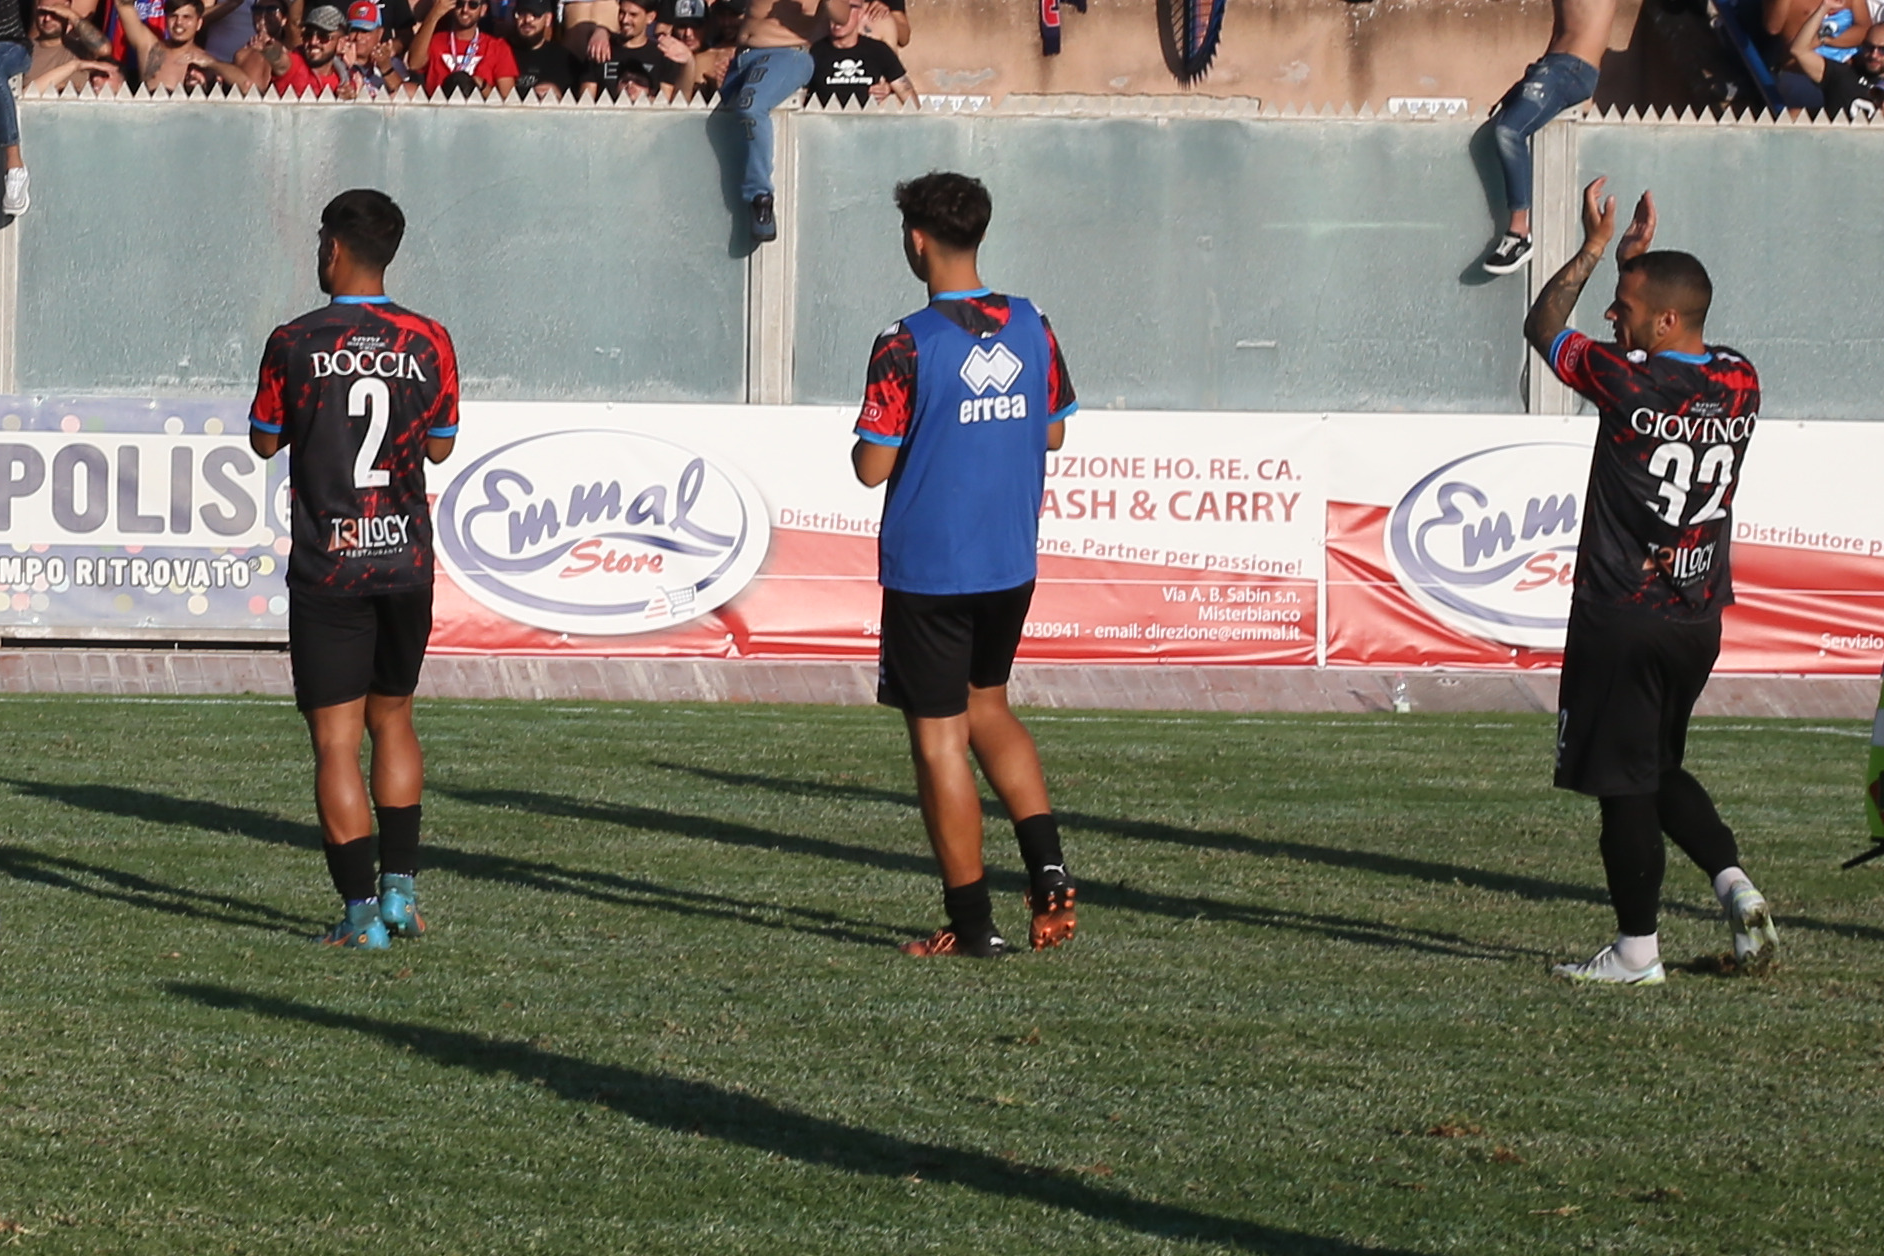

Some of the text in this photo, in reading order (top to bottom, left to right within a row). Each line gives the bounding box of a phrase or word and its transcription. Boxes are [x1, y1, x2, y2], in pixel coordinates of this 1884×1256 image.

[310, 350, 427, 382] BOCCIA
[959, 394, 1027, 424] errea
[1630, 407, 1757, 443] GIOVINCO
[347, 377, 391, 488] 2
[1154, 458, 1197, 481] HO.
[1210, 459, 1249, 481] RE.
[1256, 459, 1302, 482] CA.
[1646, 442, 1735, 527] 32
[462, 457, 735, 571] Emmal
[1040, 488, 1301, 523] ASH & CARRY
[327, 515, 410, 552] TRILOGY
[1415, 481, 1577, 586] Emm
[1736, 522, 1864, 552] Distributore
[559, 539, 663, 578] Store
[1082, 538, 1161, 564] Partner
[1165, 547, 1199, 567] per
[1203, 551, 1303, 576] passione!
[1162, 587, 1301, 604] Via A. B. Sabin s.n.
[1198, 606, 1300, 622] Misterbianco
[1022, 623, 1080, 639] 030941
[1094, 624, 1141, 640] email:
[1145, 623, 1301, 642] direzione@emmal.it
